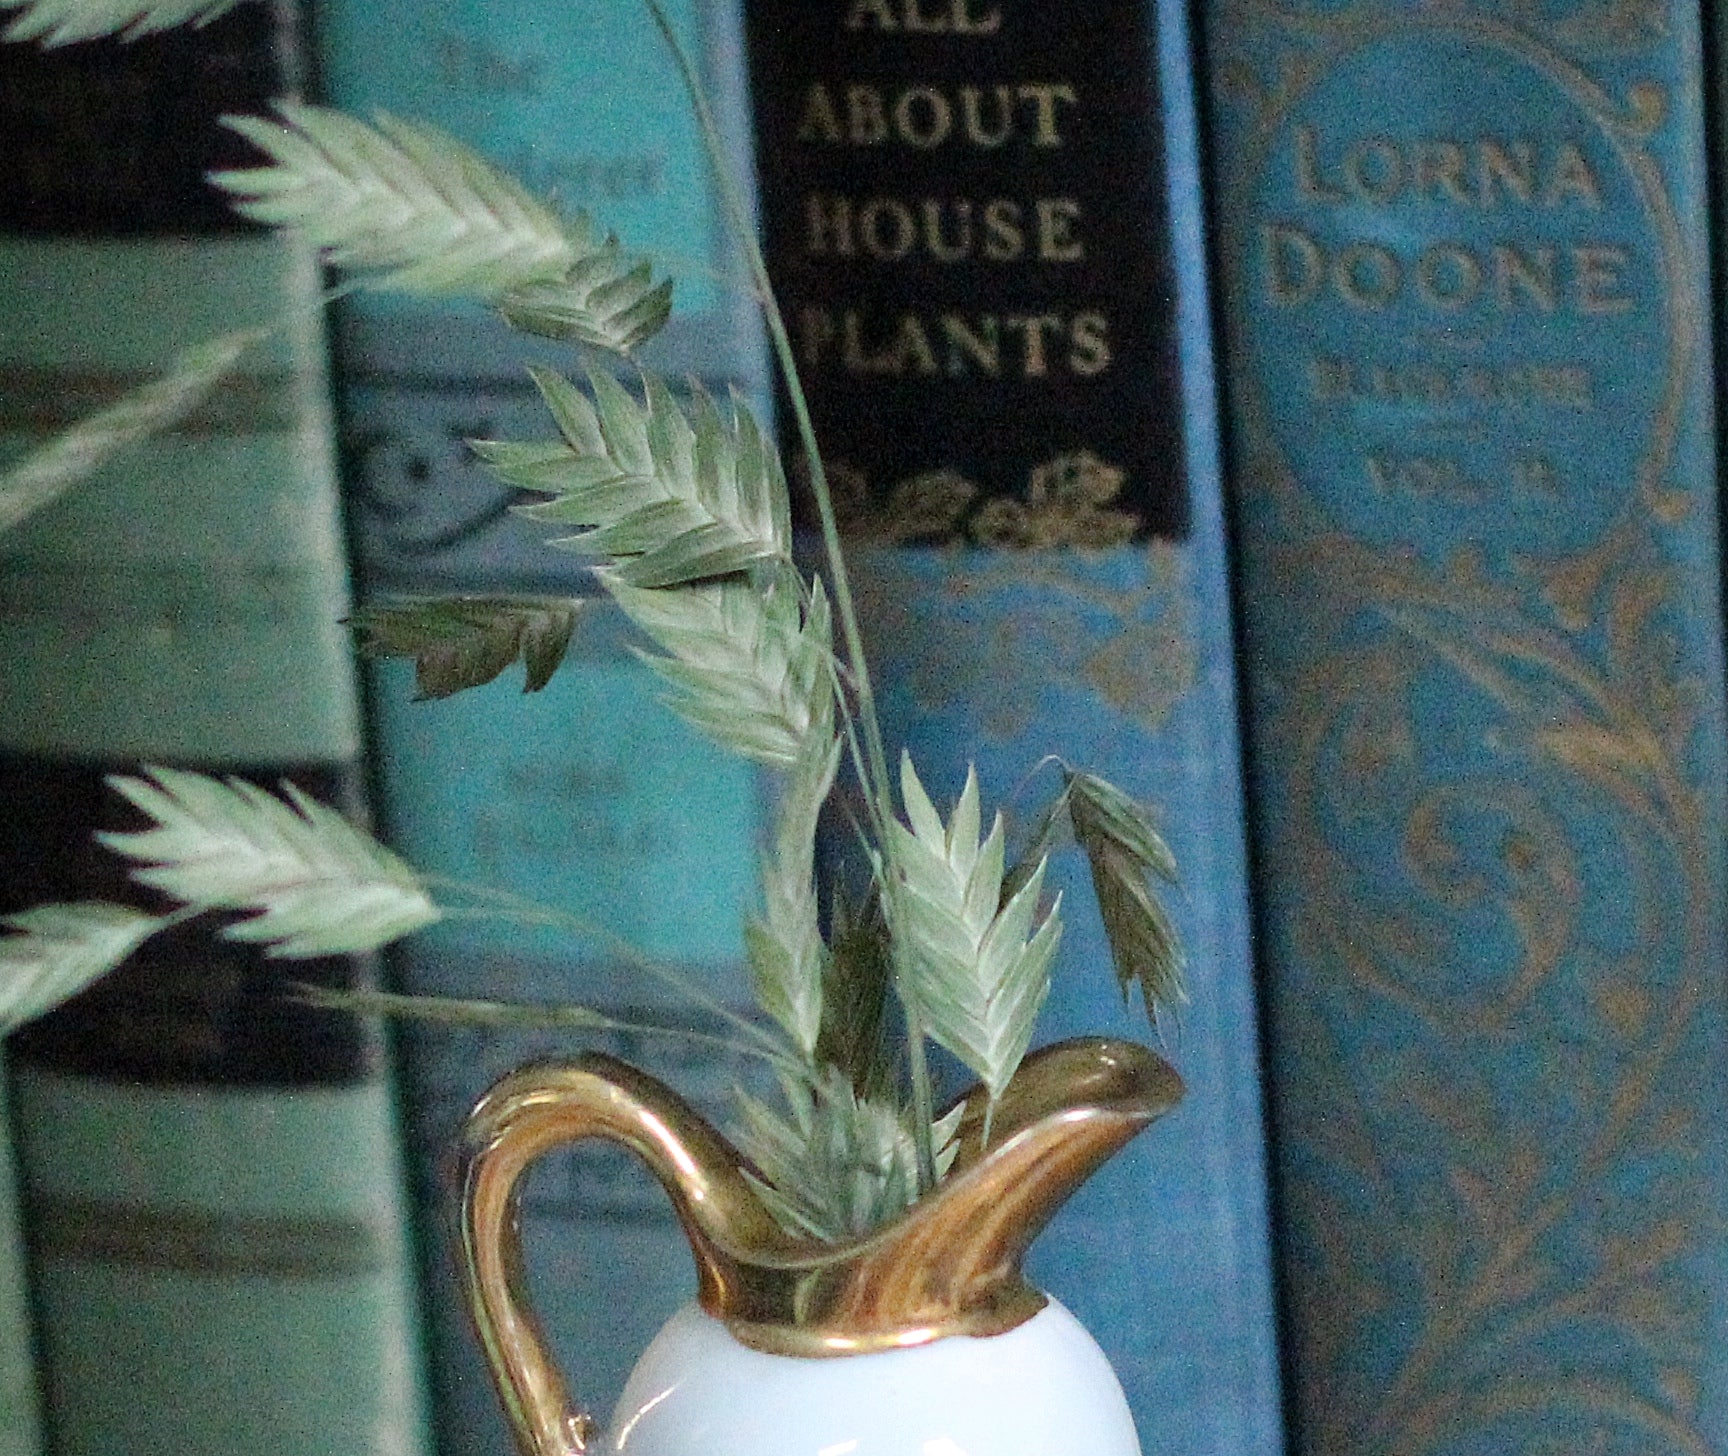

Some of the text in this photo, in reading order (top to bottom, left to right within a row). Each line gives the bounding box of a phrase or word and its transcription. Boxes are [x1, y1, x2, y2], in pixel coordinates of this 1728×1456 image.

[796, 83, 1078, 149] ABOUT
[1292, 123, 1603, 209] LORNA
[806, 197, 1087, 262] HOUSE
[1261, 220, 1636, 313] DOONE
[799, 307, 1113, 379] PLANTS
